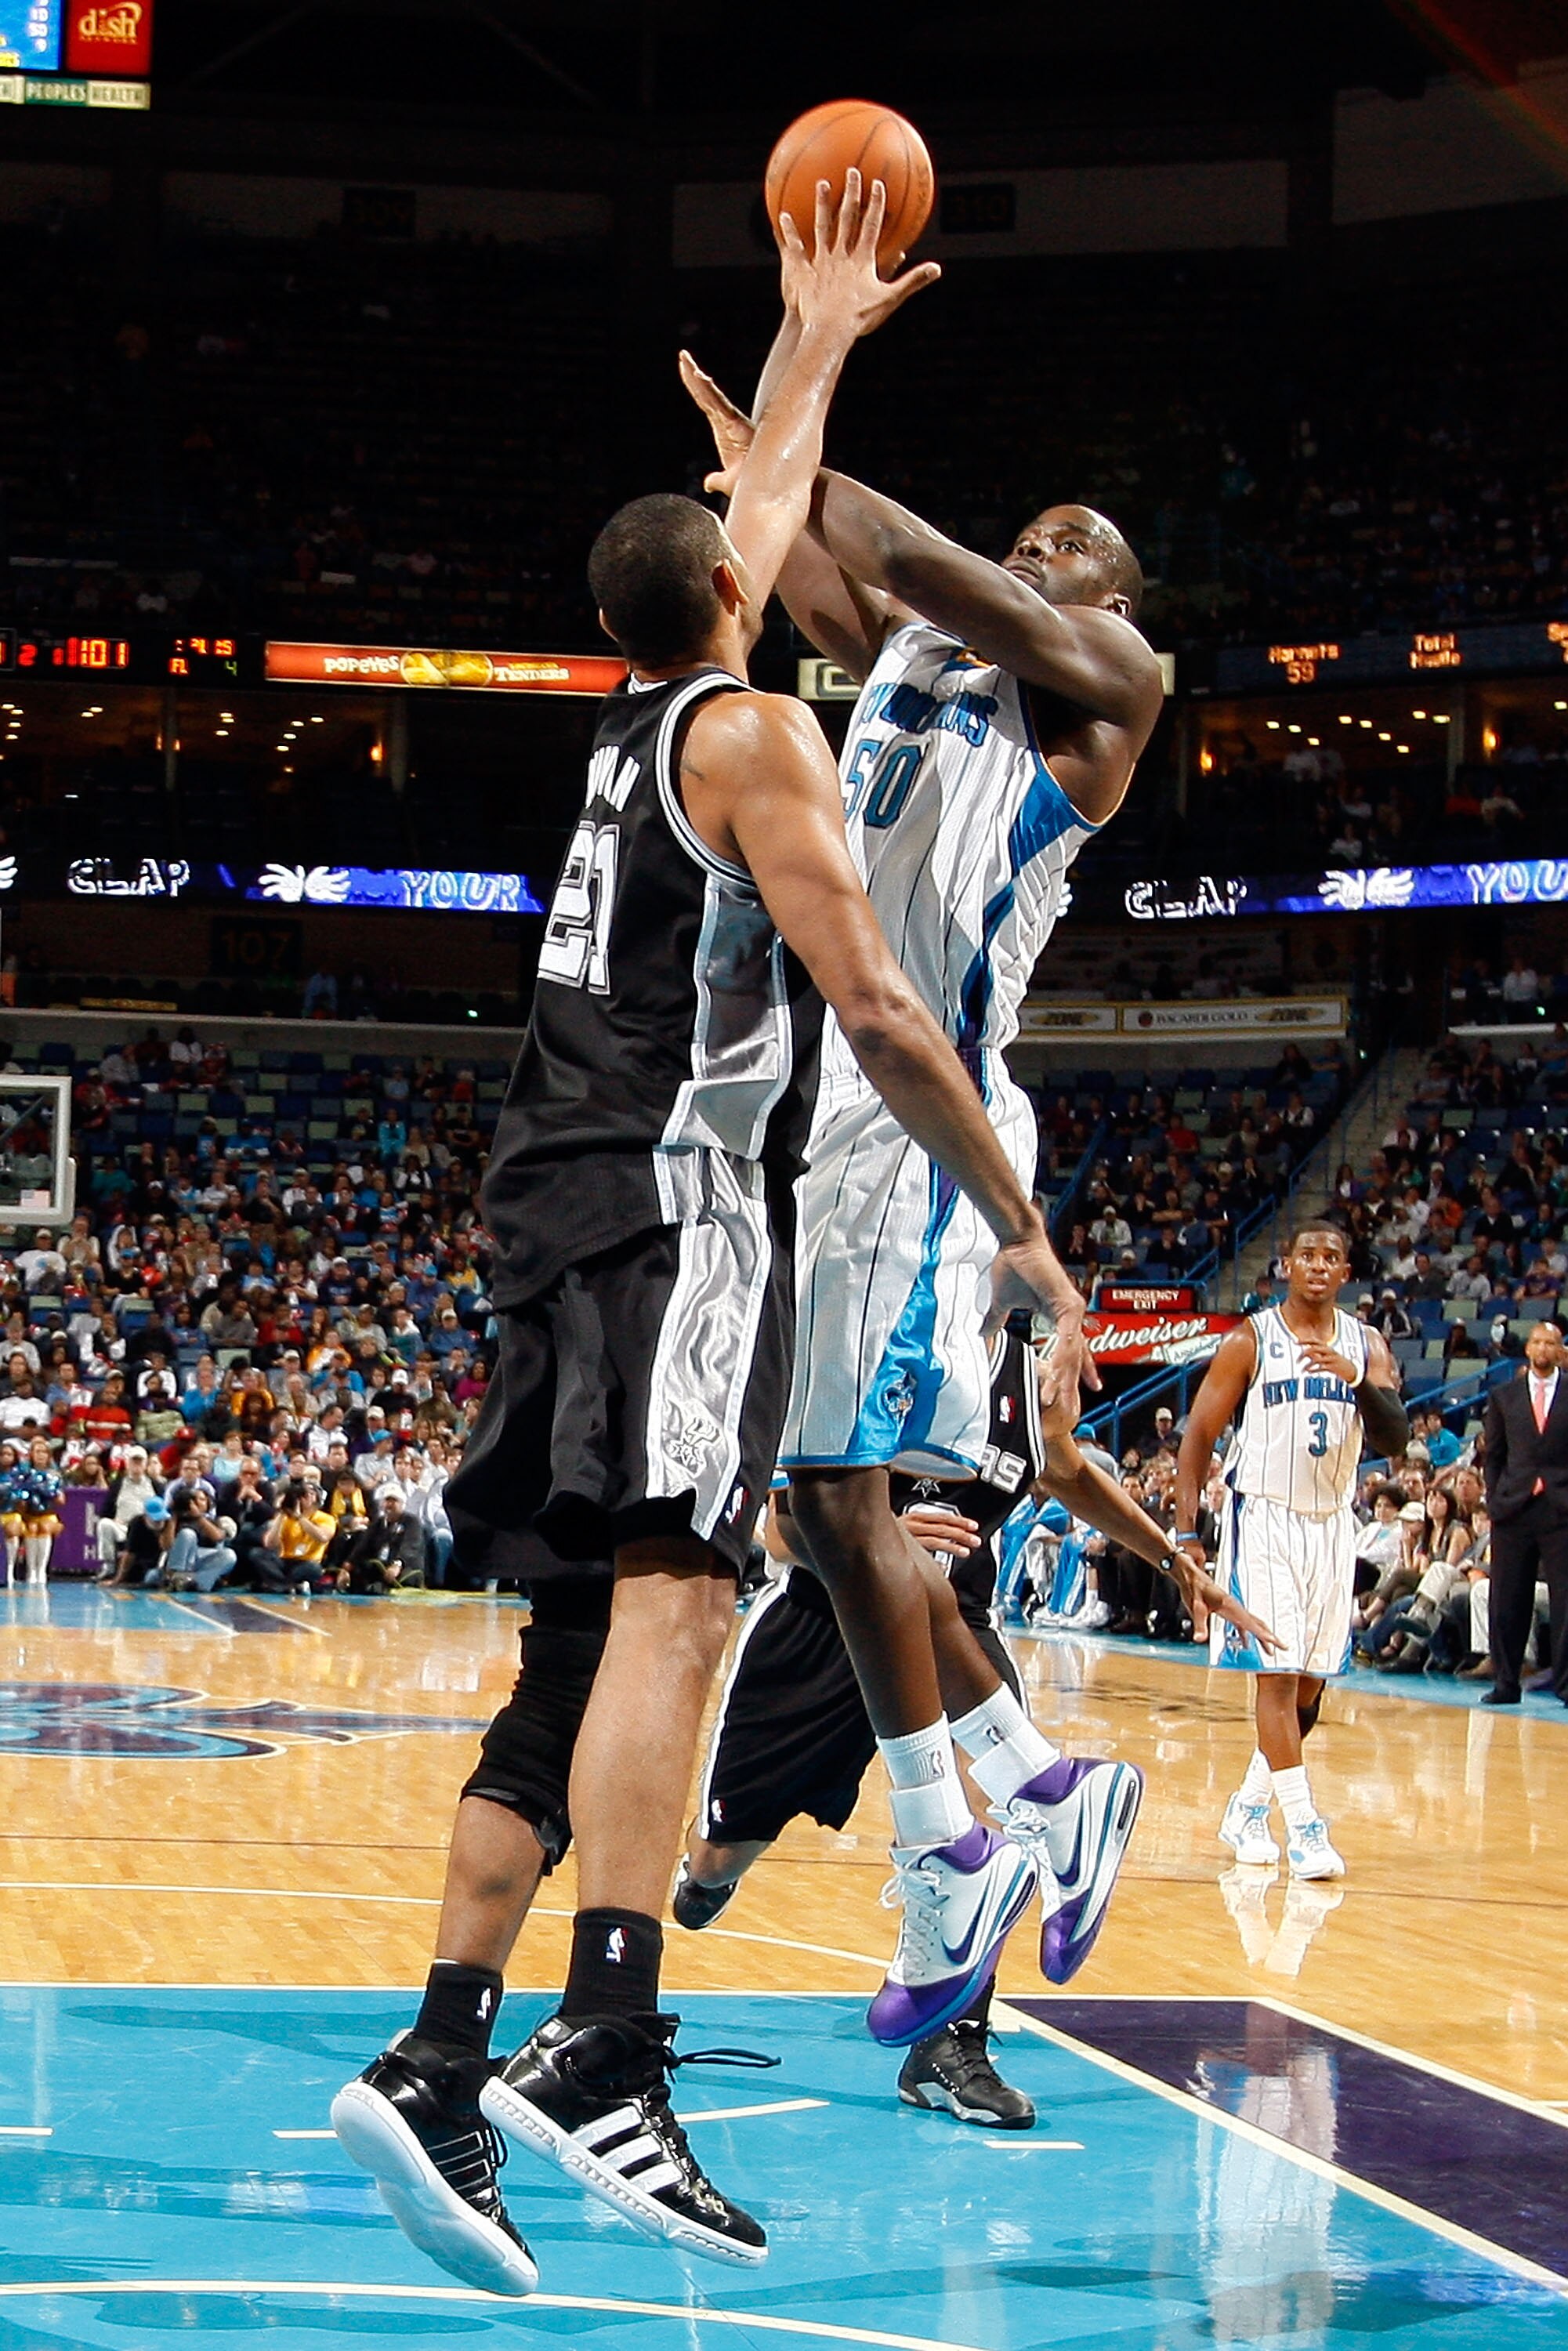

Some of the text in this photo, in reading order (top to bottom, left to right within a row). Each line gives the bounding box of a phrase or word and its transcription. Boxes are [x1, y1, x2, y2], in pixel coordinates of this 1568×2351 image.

[79, 9, 137, 38] dish
[1286, 661, 1315, 684] 59
[845, 738, 922, 829] 50
[67, 857, 521, 912] CLAP YOUR
[537, 820, 620, 995] 21
[1112, 1289, 1180, 1300] EMERGENCY
[1133, 1299, 1157, 1310] EXIT
[1038, 1317, 1208, 1360] dweiser
[1269, 1342, 1285, 1359] C
[1262, 1377, 1299, 1409] NEW
[1308, 1411, 1328, 1457] 3
